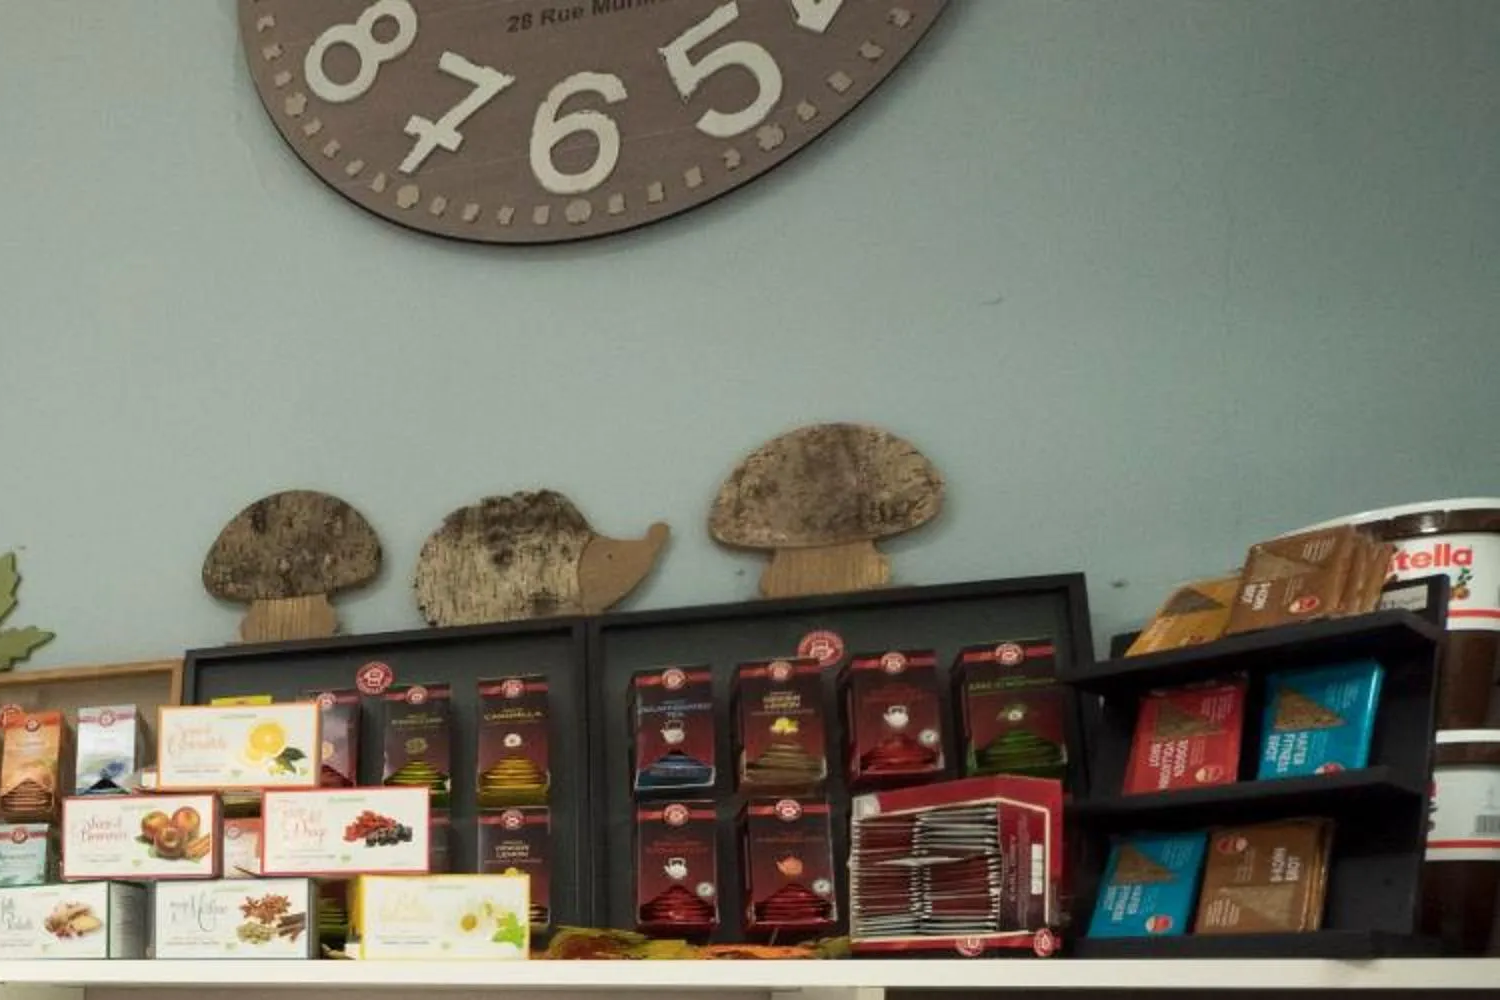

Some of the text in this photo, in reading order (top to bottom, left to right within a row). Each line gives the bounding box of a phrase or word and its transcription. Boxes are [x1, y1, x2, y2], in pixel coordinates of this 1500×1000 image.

[303, 0, 418, 101] 8
[505, 12, 533, 33] 28
[540, 6, 585, 26] Rue
[657, 1, 784, 138] 5
[400, 52, 515, 173] 7
[528, 72, 630, 193] 6
[1387, 543, 1474, 571] tella
